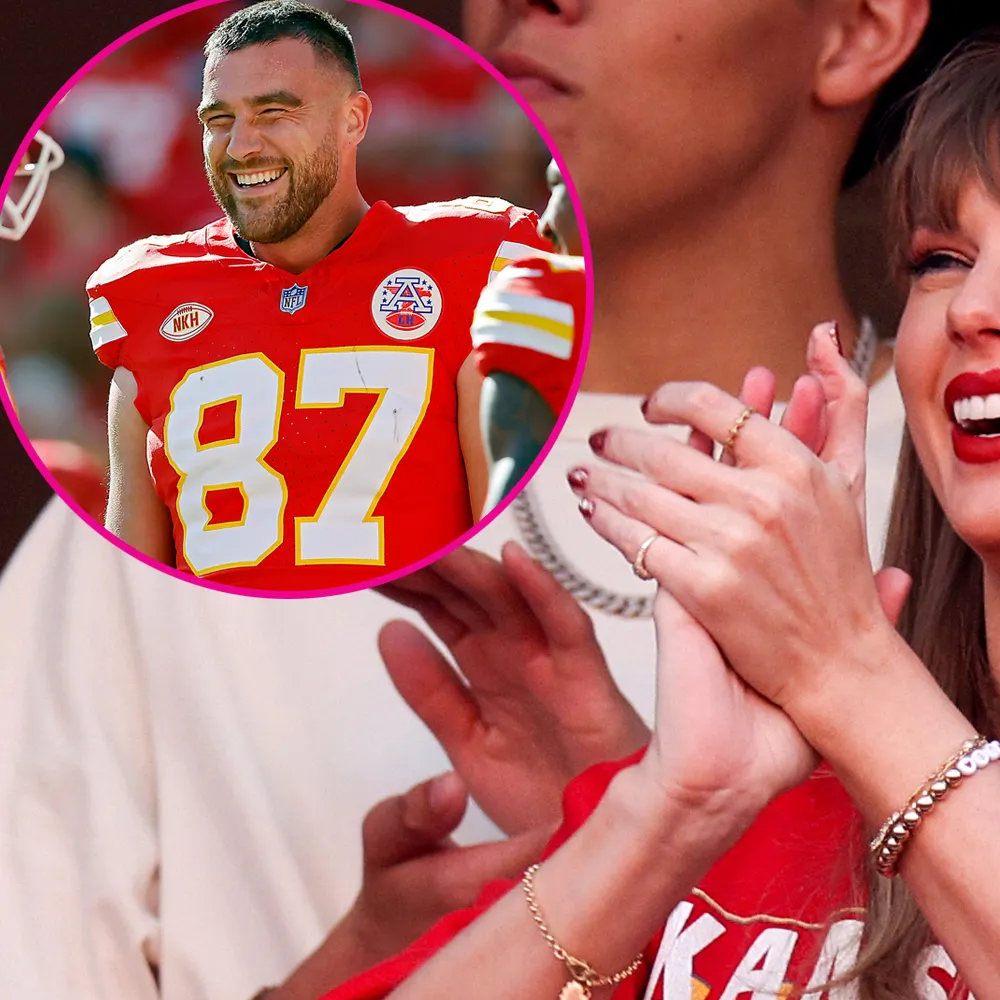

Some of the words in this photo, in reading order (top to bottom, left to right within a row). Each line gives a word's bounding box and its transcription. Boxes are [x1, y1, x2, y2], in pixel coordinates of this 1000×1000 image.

[283, 296, 303, 308] NFL
[173, 311, 199, 333] NKH
[164, 345, 435, 577] 87
